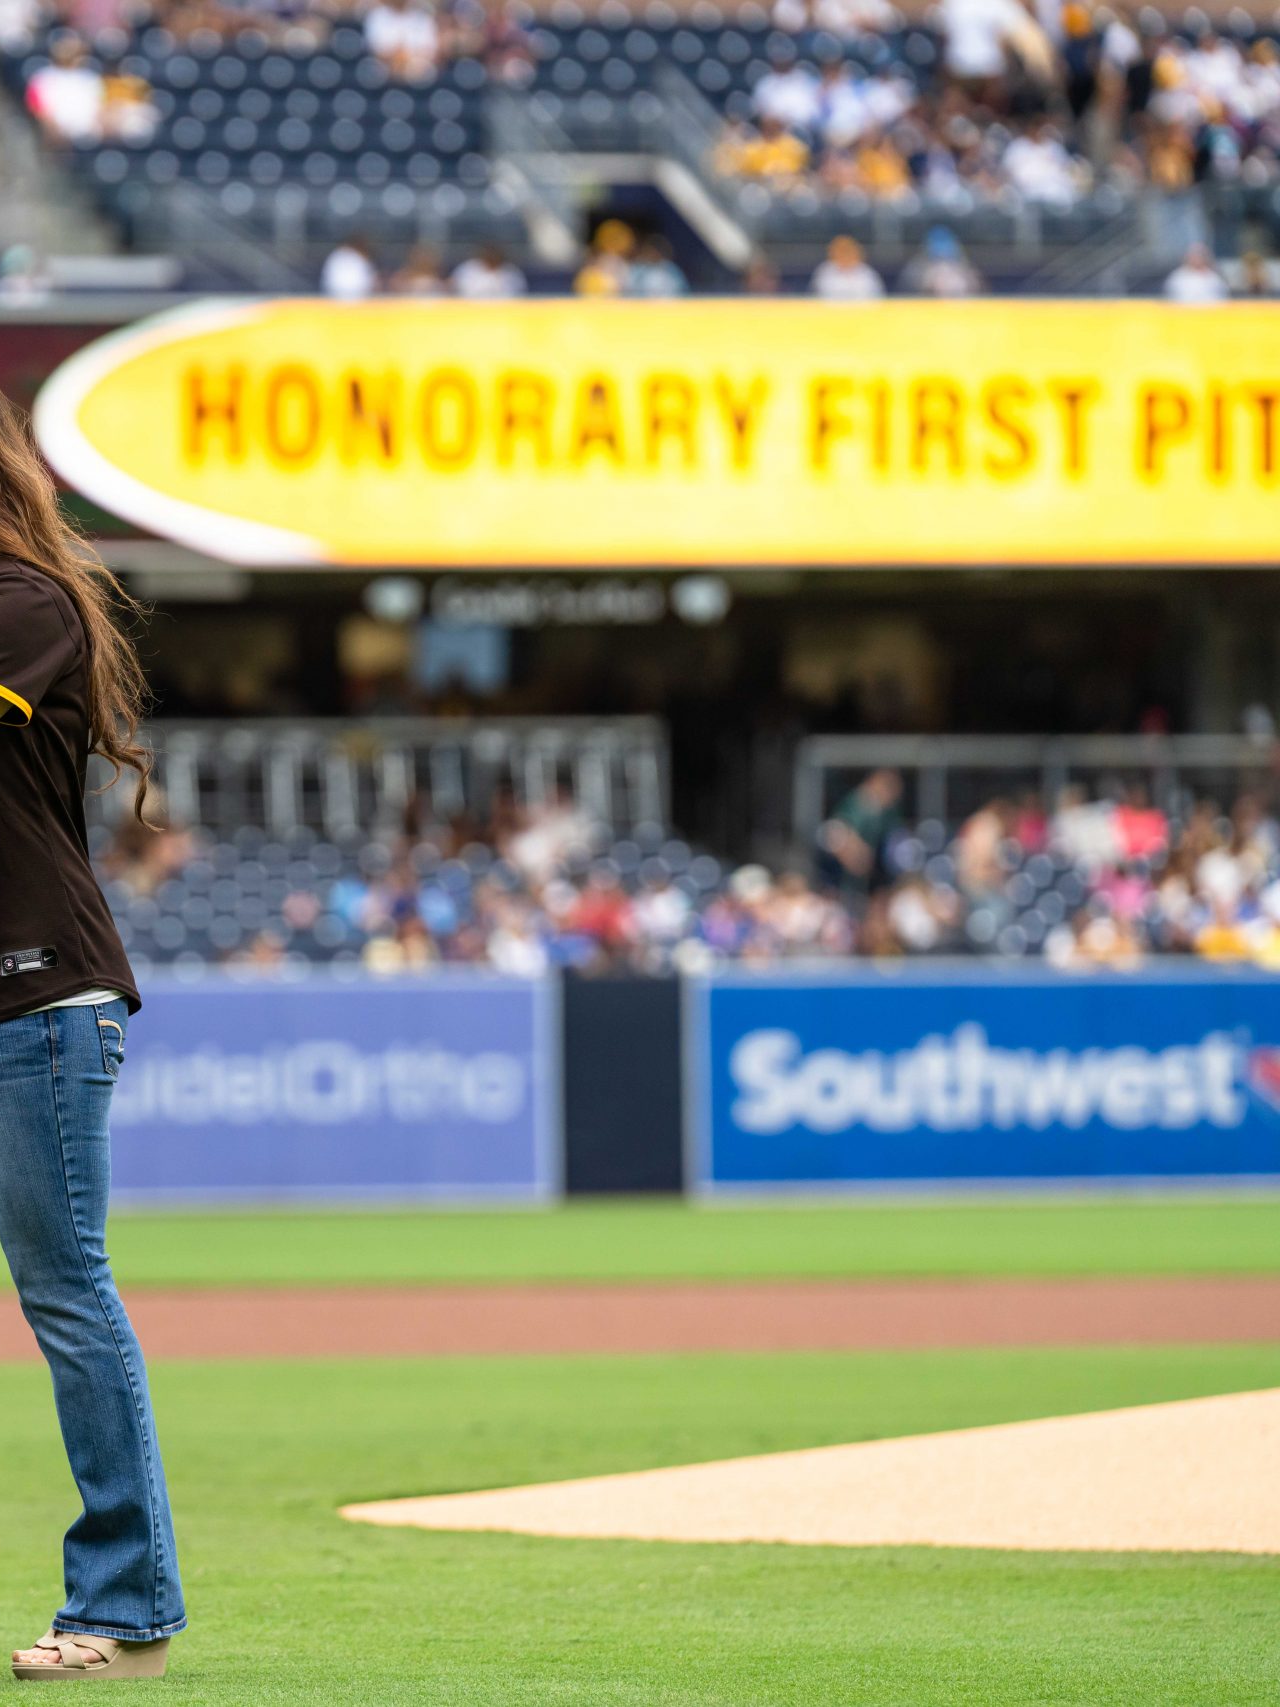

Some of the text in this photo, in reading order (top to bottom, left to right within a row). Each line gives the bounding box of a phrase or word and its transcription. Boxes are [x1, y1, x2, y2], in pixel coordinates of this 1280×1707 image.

[185, 363, 1280, 484] HONORARY FIRST PIT
[730, 1022, 1246, 1134] Southwest
